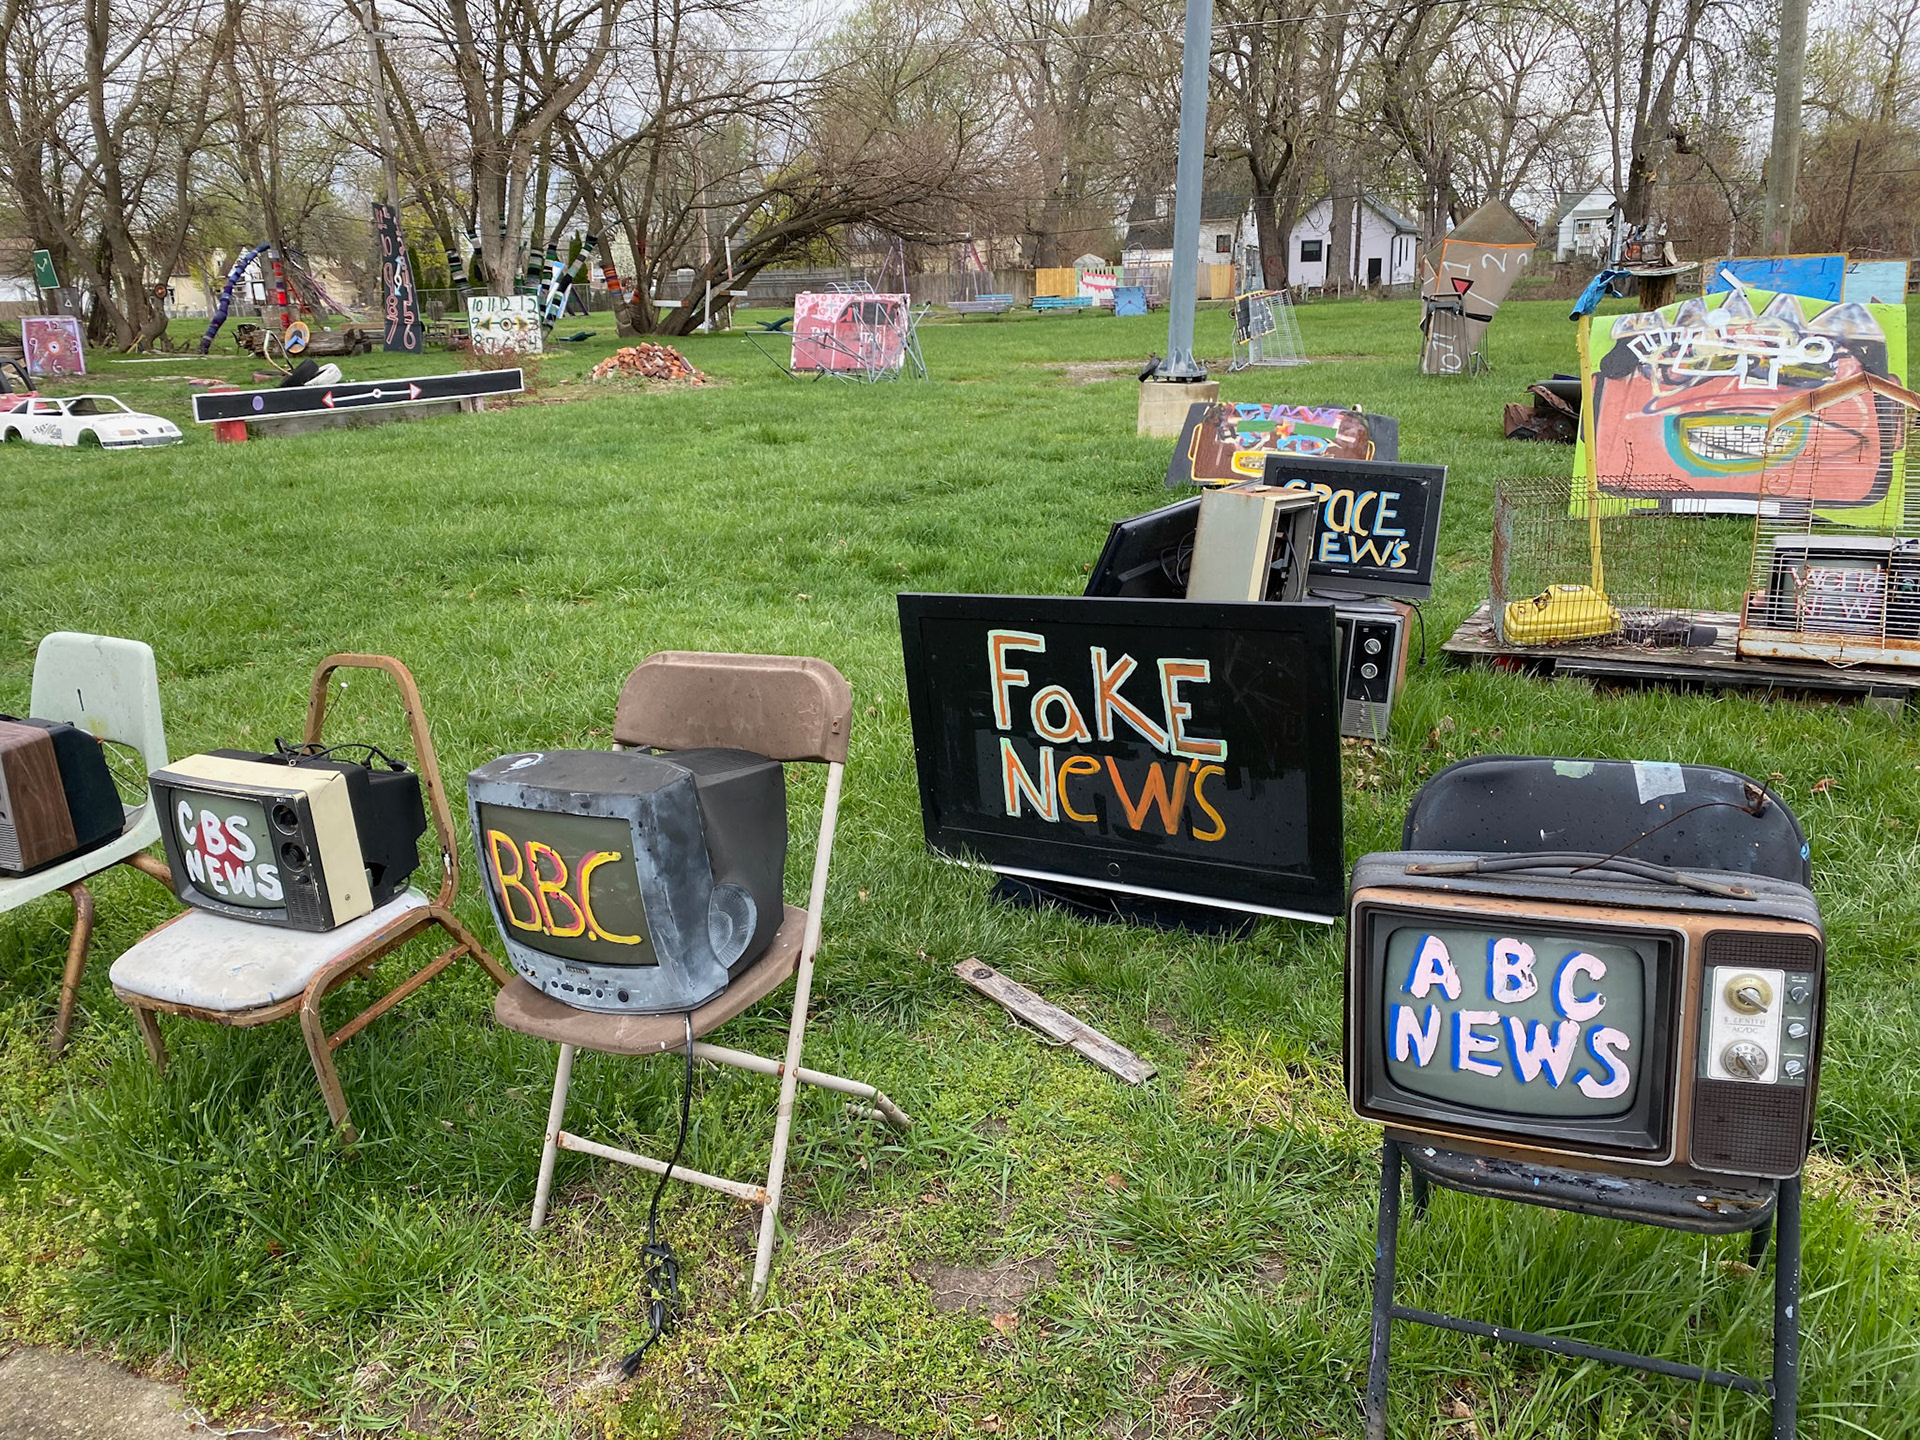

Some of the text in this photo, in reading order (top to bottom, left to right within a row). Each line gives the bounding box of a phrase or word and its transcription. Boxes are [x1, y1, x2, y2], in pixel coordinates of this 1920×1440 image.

[380, 234, 392, 257] 10
[1481, 252, 1507, 273] 2
[1768, 258, 1789, 275] 12
[386, 294, 398, 317] 8
[403, 300, 415, 325] 5
[472, 298, 483, 312] 10
[488, 297, 495, 312] 11
[500, 296, 513, 312] 12
[527, 298, 538, 314] 2
[45, 320, 62, 332] 12
[386, 314, 399, 345] 7
[403, 324, 417, 350] 6
[29, 337, 79, 354] 9 3
[52, 359, 63, 374] 6
[177, 800, 256, 862] CBS
[185, 849, 284, 901] NEWS
[1731, 1026, 1759, 1034] AC/DC
[1732, 1017, 1767, 1025] ZENITH
[1389, 1003, 1631, 1099] NEWS
